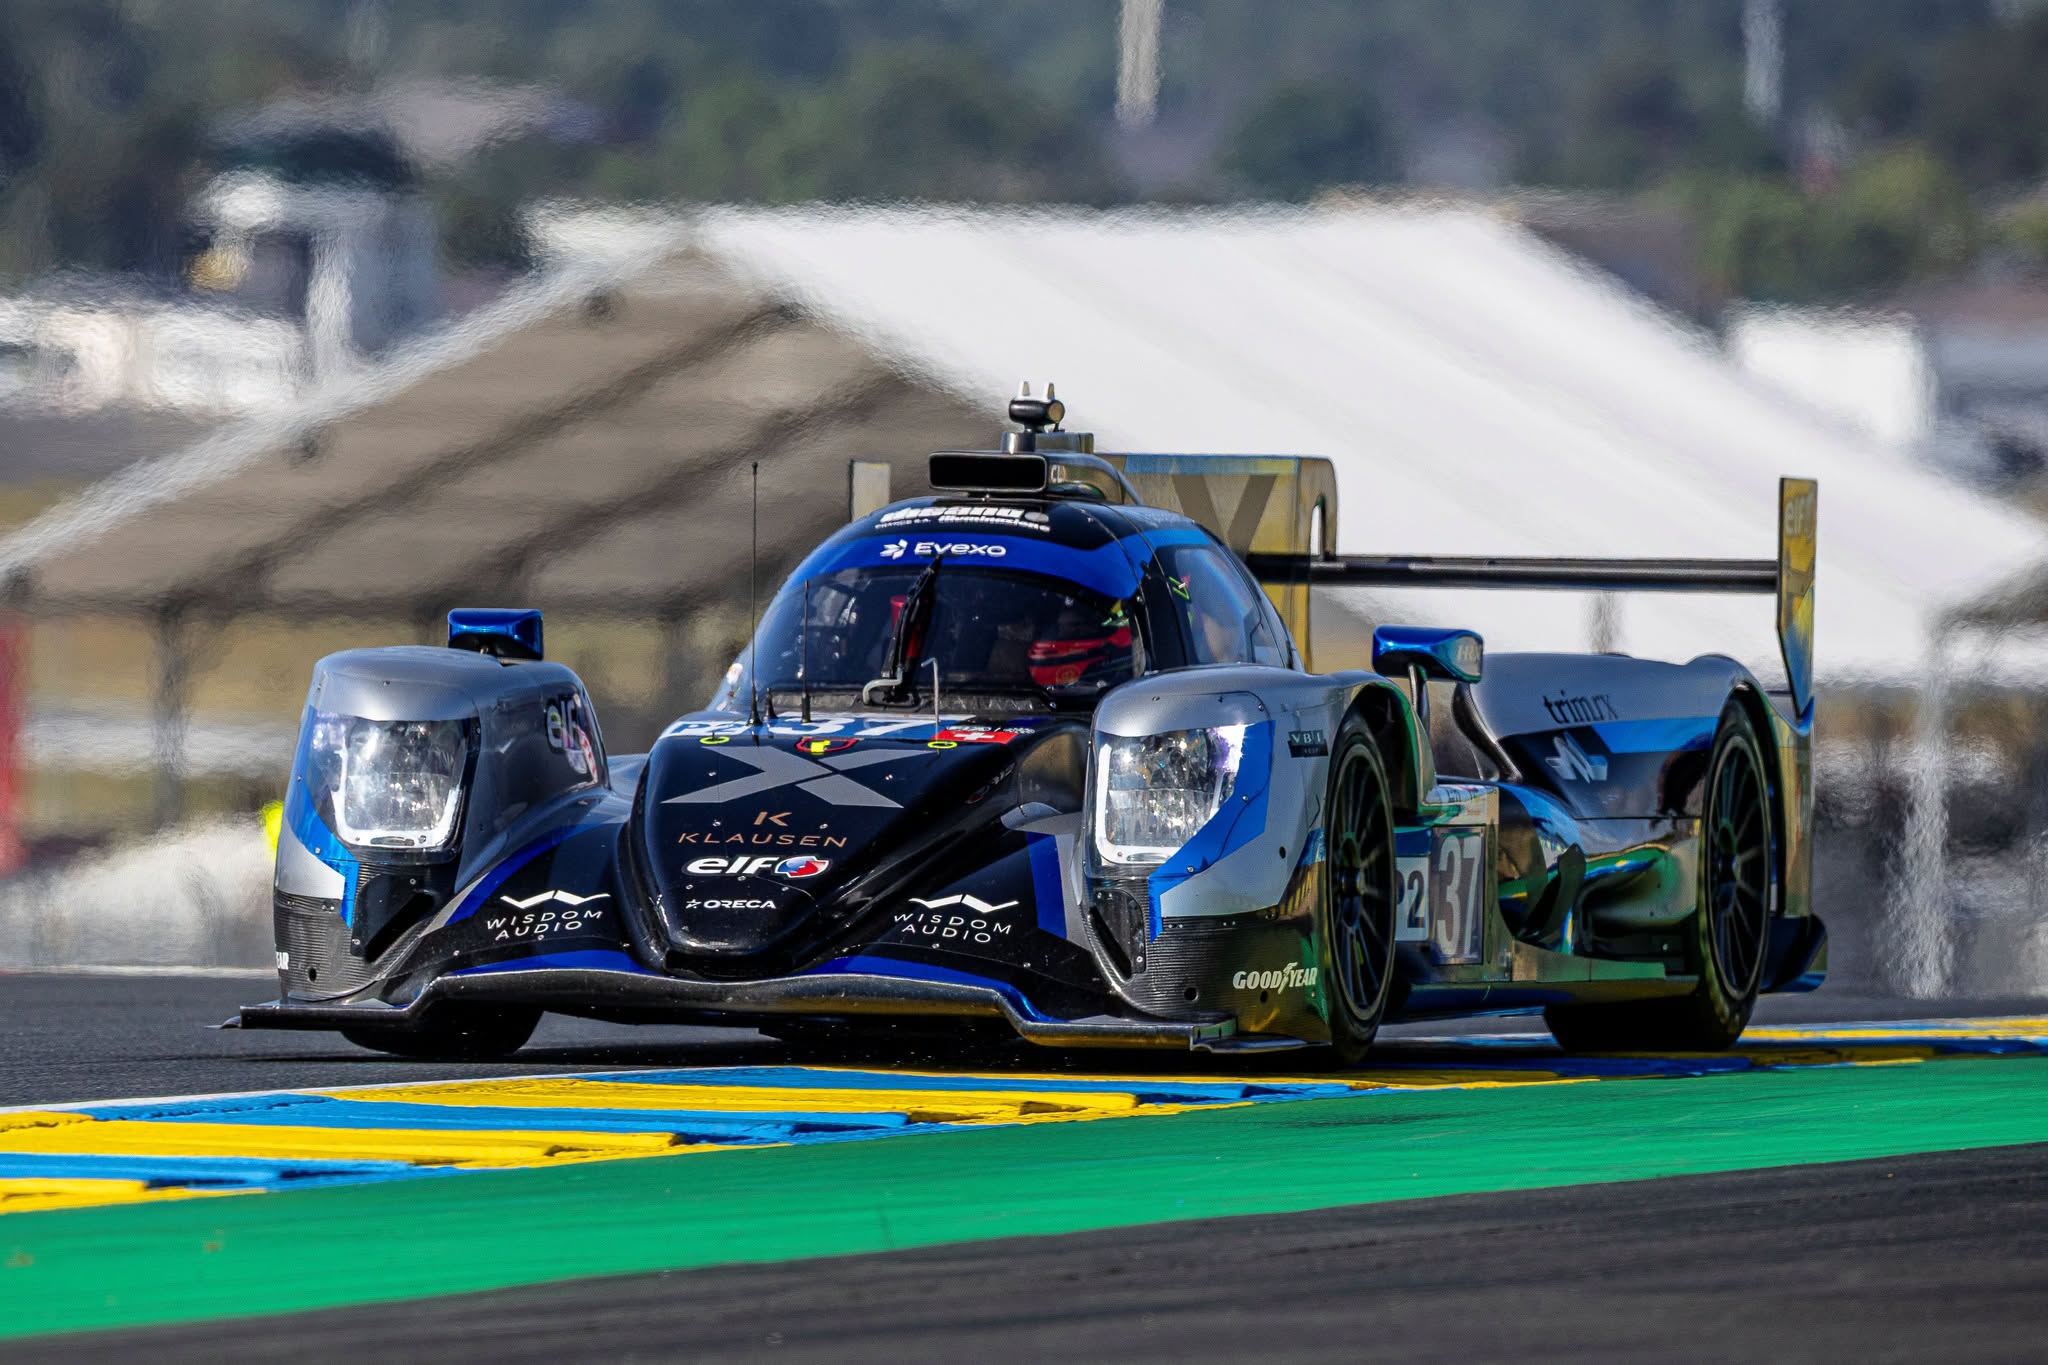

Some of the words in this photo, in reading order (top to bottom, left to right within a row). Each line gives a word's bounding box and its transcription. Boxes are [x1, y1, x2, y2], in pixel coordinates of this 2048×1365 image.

[914, 541, 1007, 557] Evexo
[768, 717, 937, 736] 37
[678, 832, 848, 848] KLAUSEN
[686, 856, 780, 875] elf
[703, 900, 777, 909] ORECA
[1437, 834, 1482, 958] 37
[486, 910, 604, 930] WISDOM
[894, 913, 1012, 935] WISDOM
[495, 920, 583, 941] AUDIO
[901, 923, 992, 943] AUDIO
[1232, 963, 1319, 992] GOODYEAR
